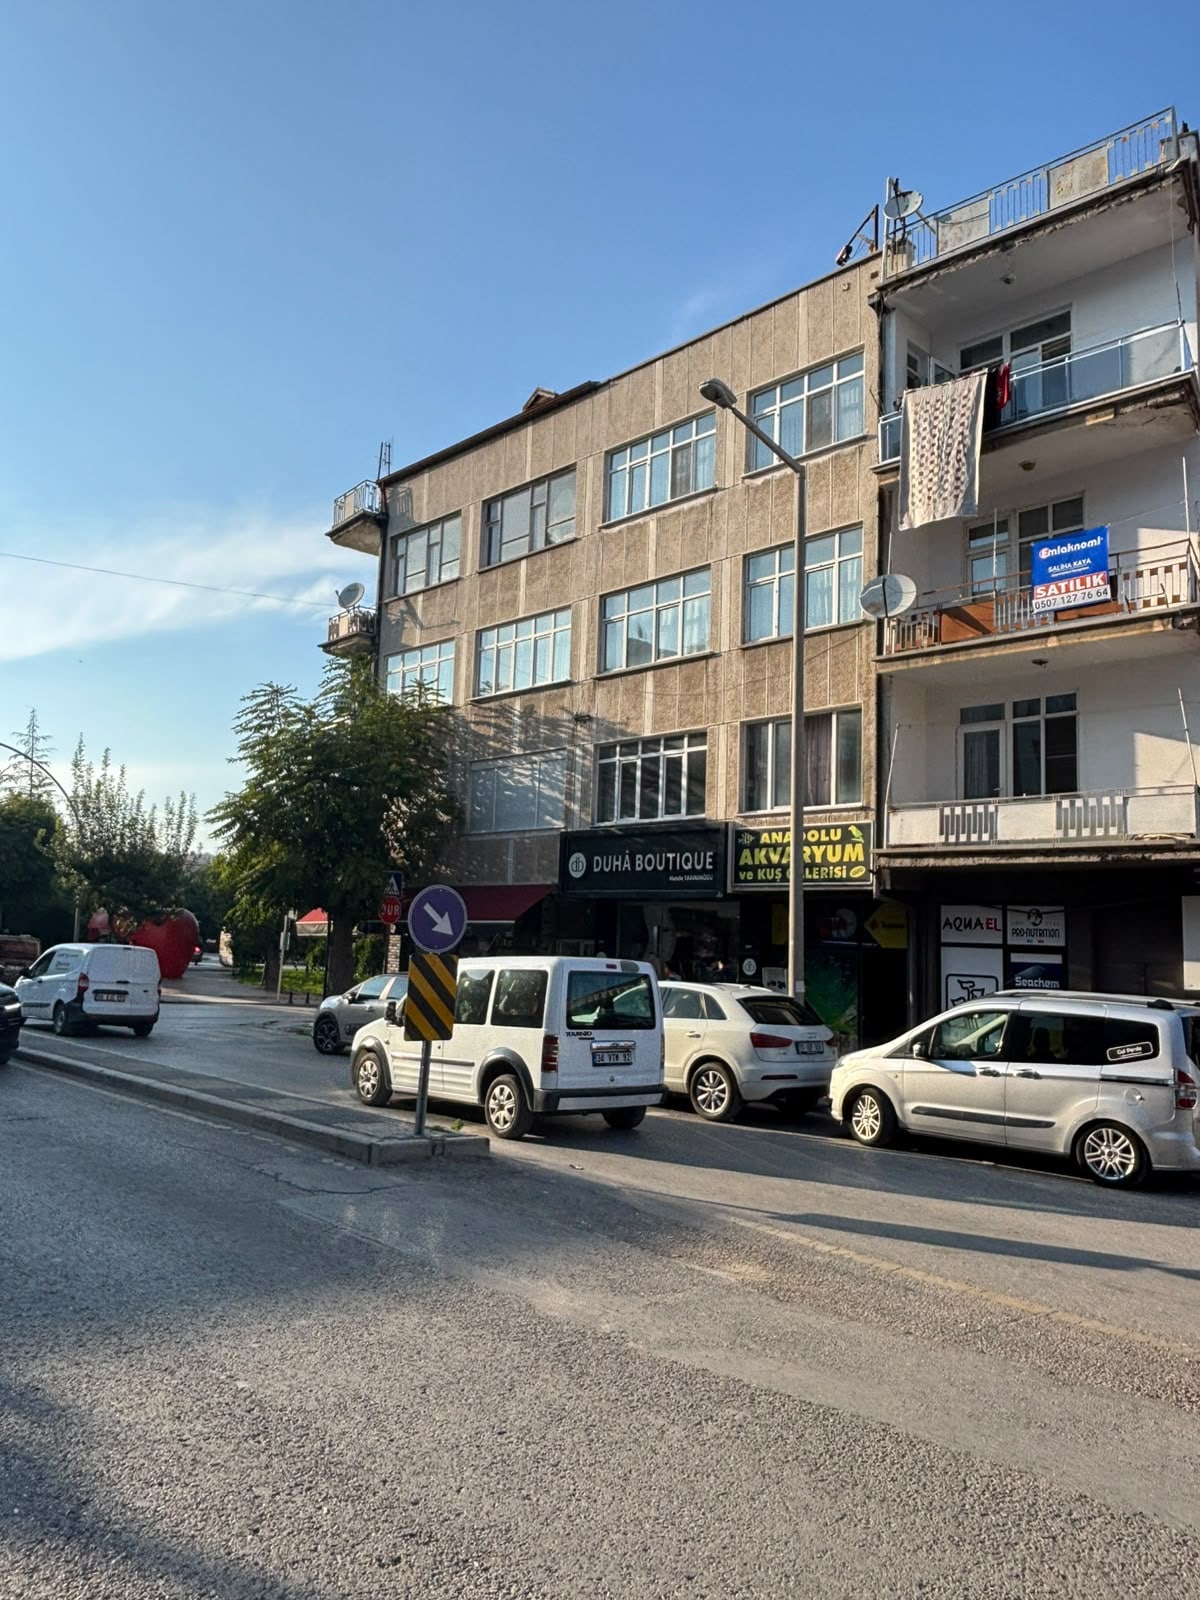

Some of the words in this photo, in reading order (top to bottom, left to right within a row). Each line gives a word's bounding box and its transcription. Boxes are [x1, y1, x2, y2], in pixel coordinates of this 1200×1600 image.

[1036, 573, 1105, 597] SATILIK
[1035, 598, 1057, 609] 0507
[1061, 594, 1078, 605] 127
[1082, 591, 1093, 600] 76
[1096, 588, 1108, 597] 64
[760, 828, 842, 844] ANAOLU
[635, 851, 714, 871] BOUTIQUE
[739, 871, 753, 880] ve
[757, 867, 782, 882] KUŞ
[787, 865, 847, 881] LERİSİ
[943, 917, 1001, 931] AQUAEL
[1015, 976, 1060, 988] Seachem
